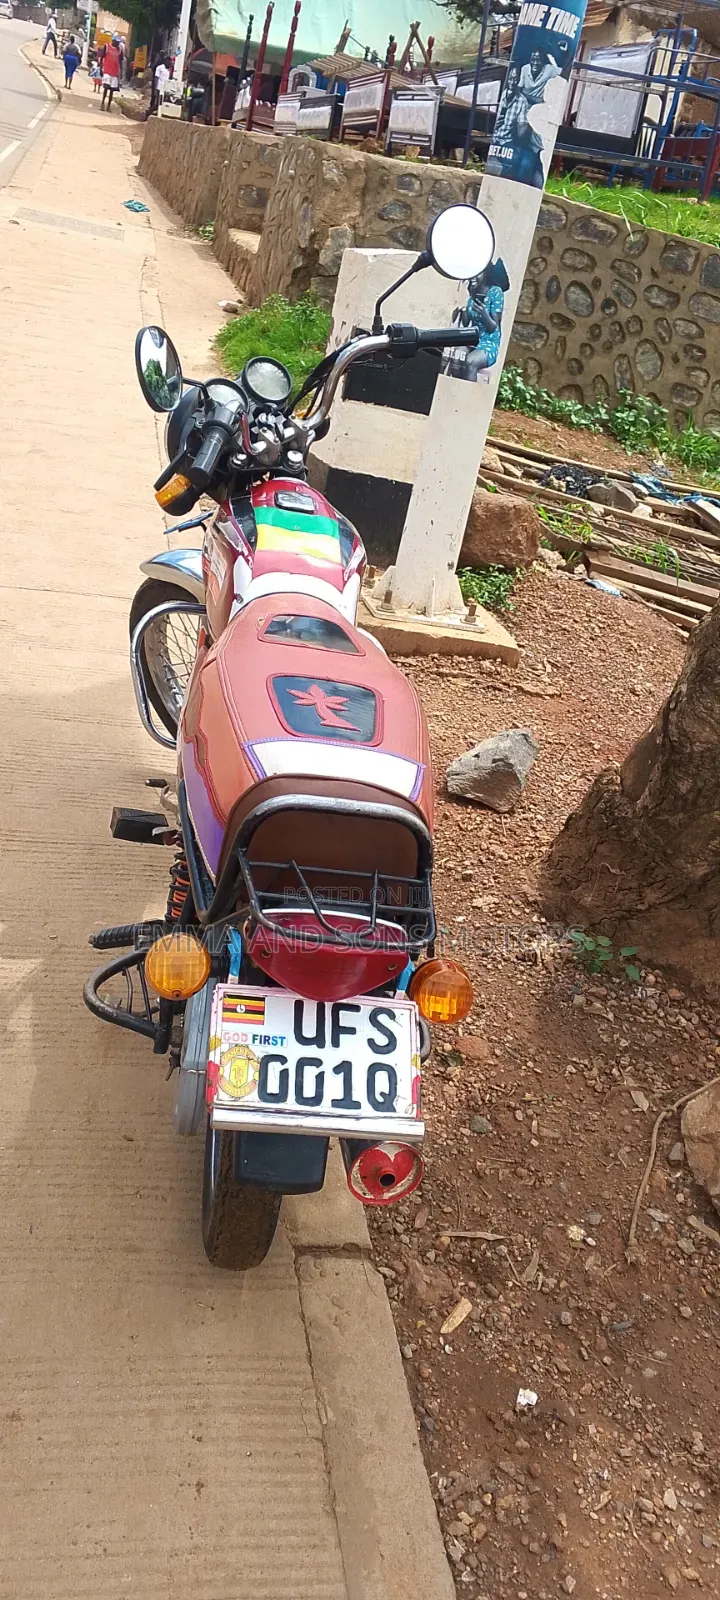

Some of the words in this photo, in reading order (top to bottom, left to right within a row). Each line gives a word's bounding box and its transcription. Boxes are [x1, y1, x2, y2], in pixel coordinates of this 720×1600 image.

[545, 7, 580, 39] TIME
[223, 1031, 248, 1042] GOD
[251, 1033, 286, 1047] FIRST
[293, 999, 397, 1055] UFS
[257, 1054, 398, 1112] 001Q
